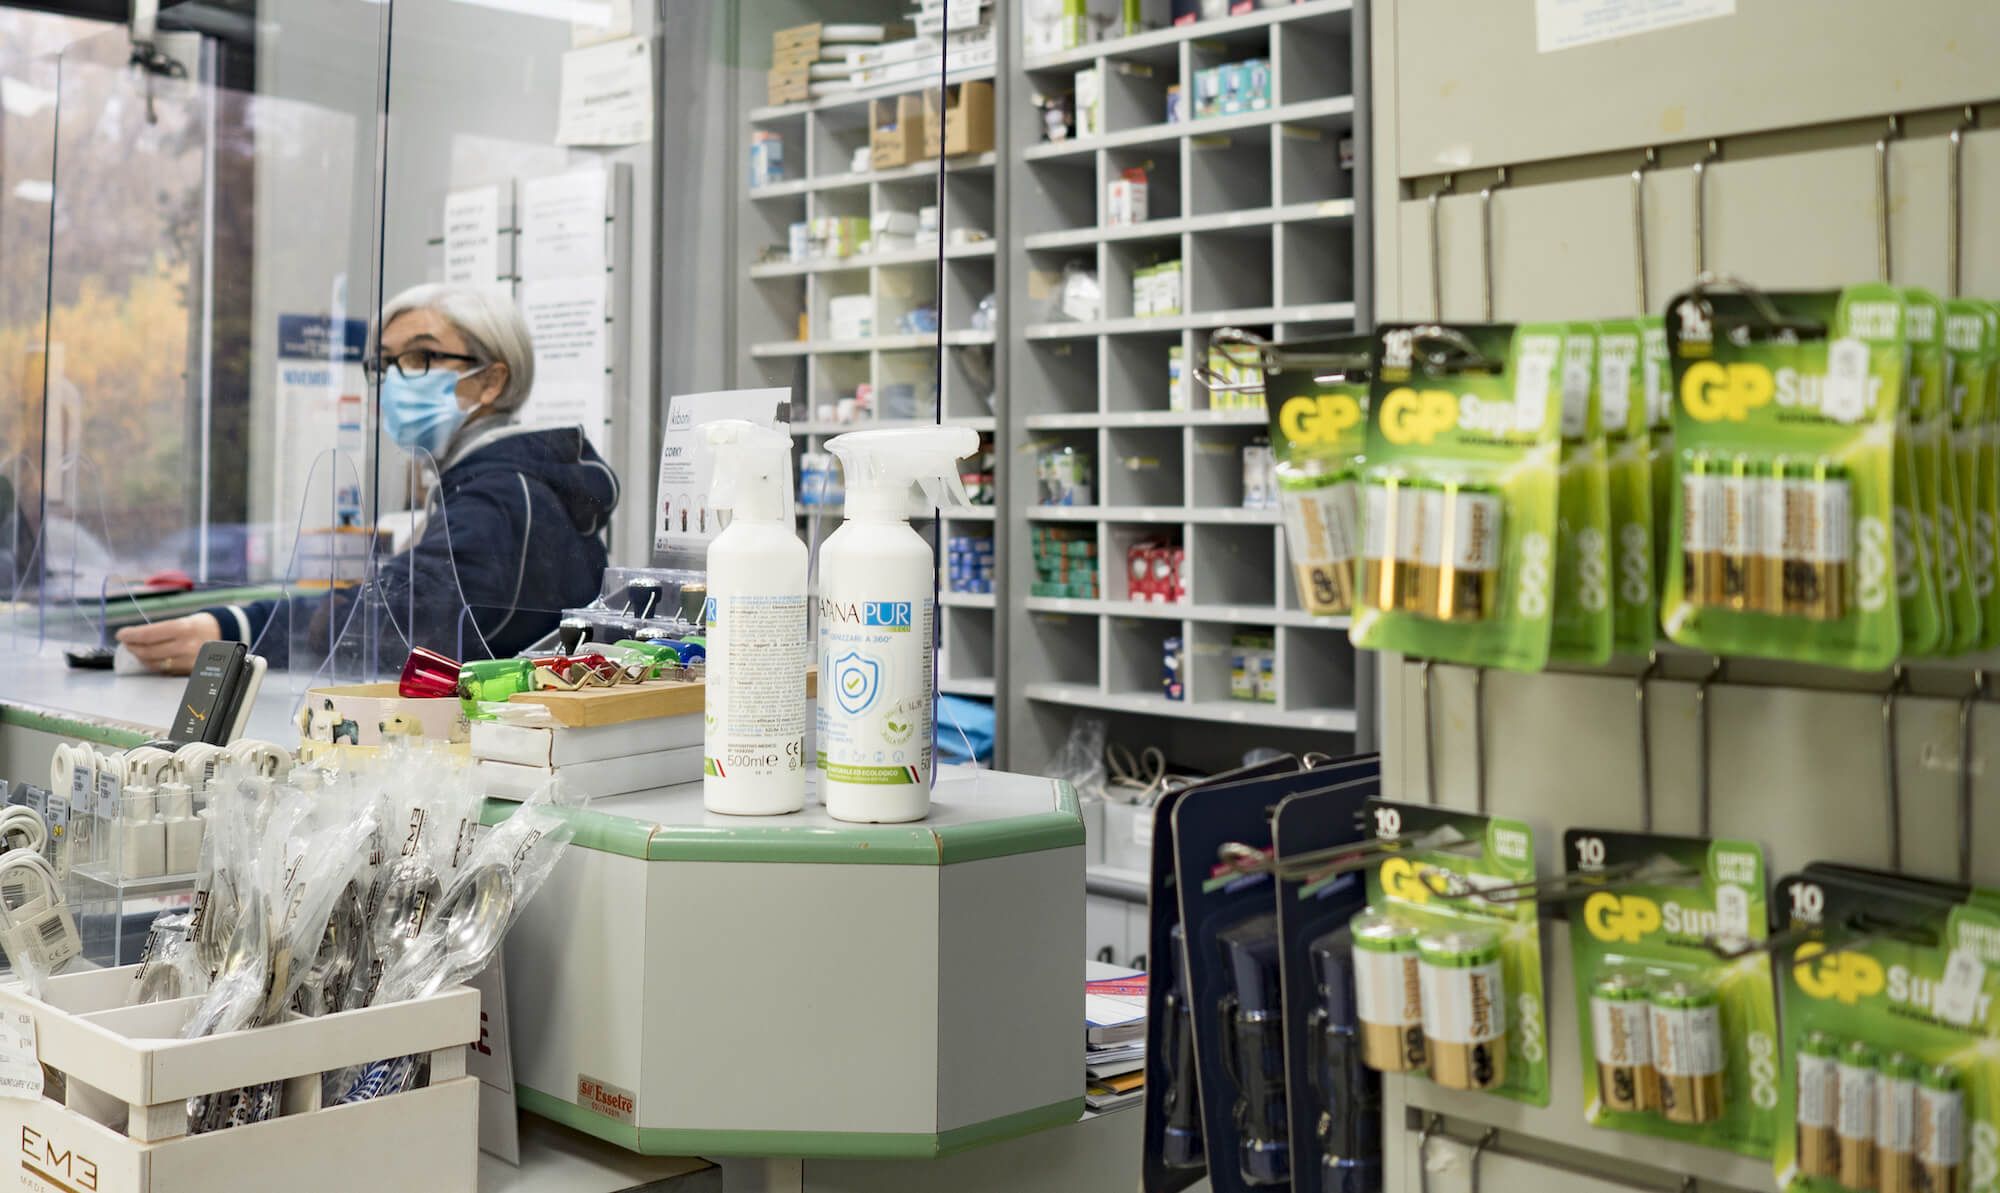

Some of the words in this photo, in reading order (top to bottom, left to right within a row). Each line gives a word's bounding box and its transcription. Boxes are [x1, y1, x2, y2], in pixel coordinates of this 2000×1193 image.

[1680, 360, 1774, 422] GP
[1775, 367, 1883, 410] Sur
[1279, 395, 1361, 444] GP
[1379, 387, 1459, 445] GP
[864, 602, 909, 625] PUR
[727, 756, 765, 768] 500ml
[1374, 807, 1401, 833] 10
[1575, 837, 1606, 864] 10
[1788, 882, 1825, 911] 10
[1584, 891, 1662, 944] GP
[1793, 941, 1886, 1004] GP
[1887, 965, 1990, 1024] Sur
